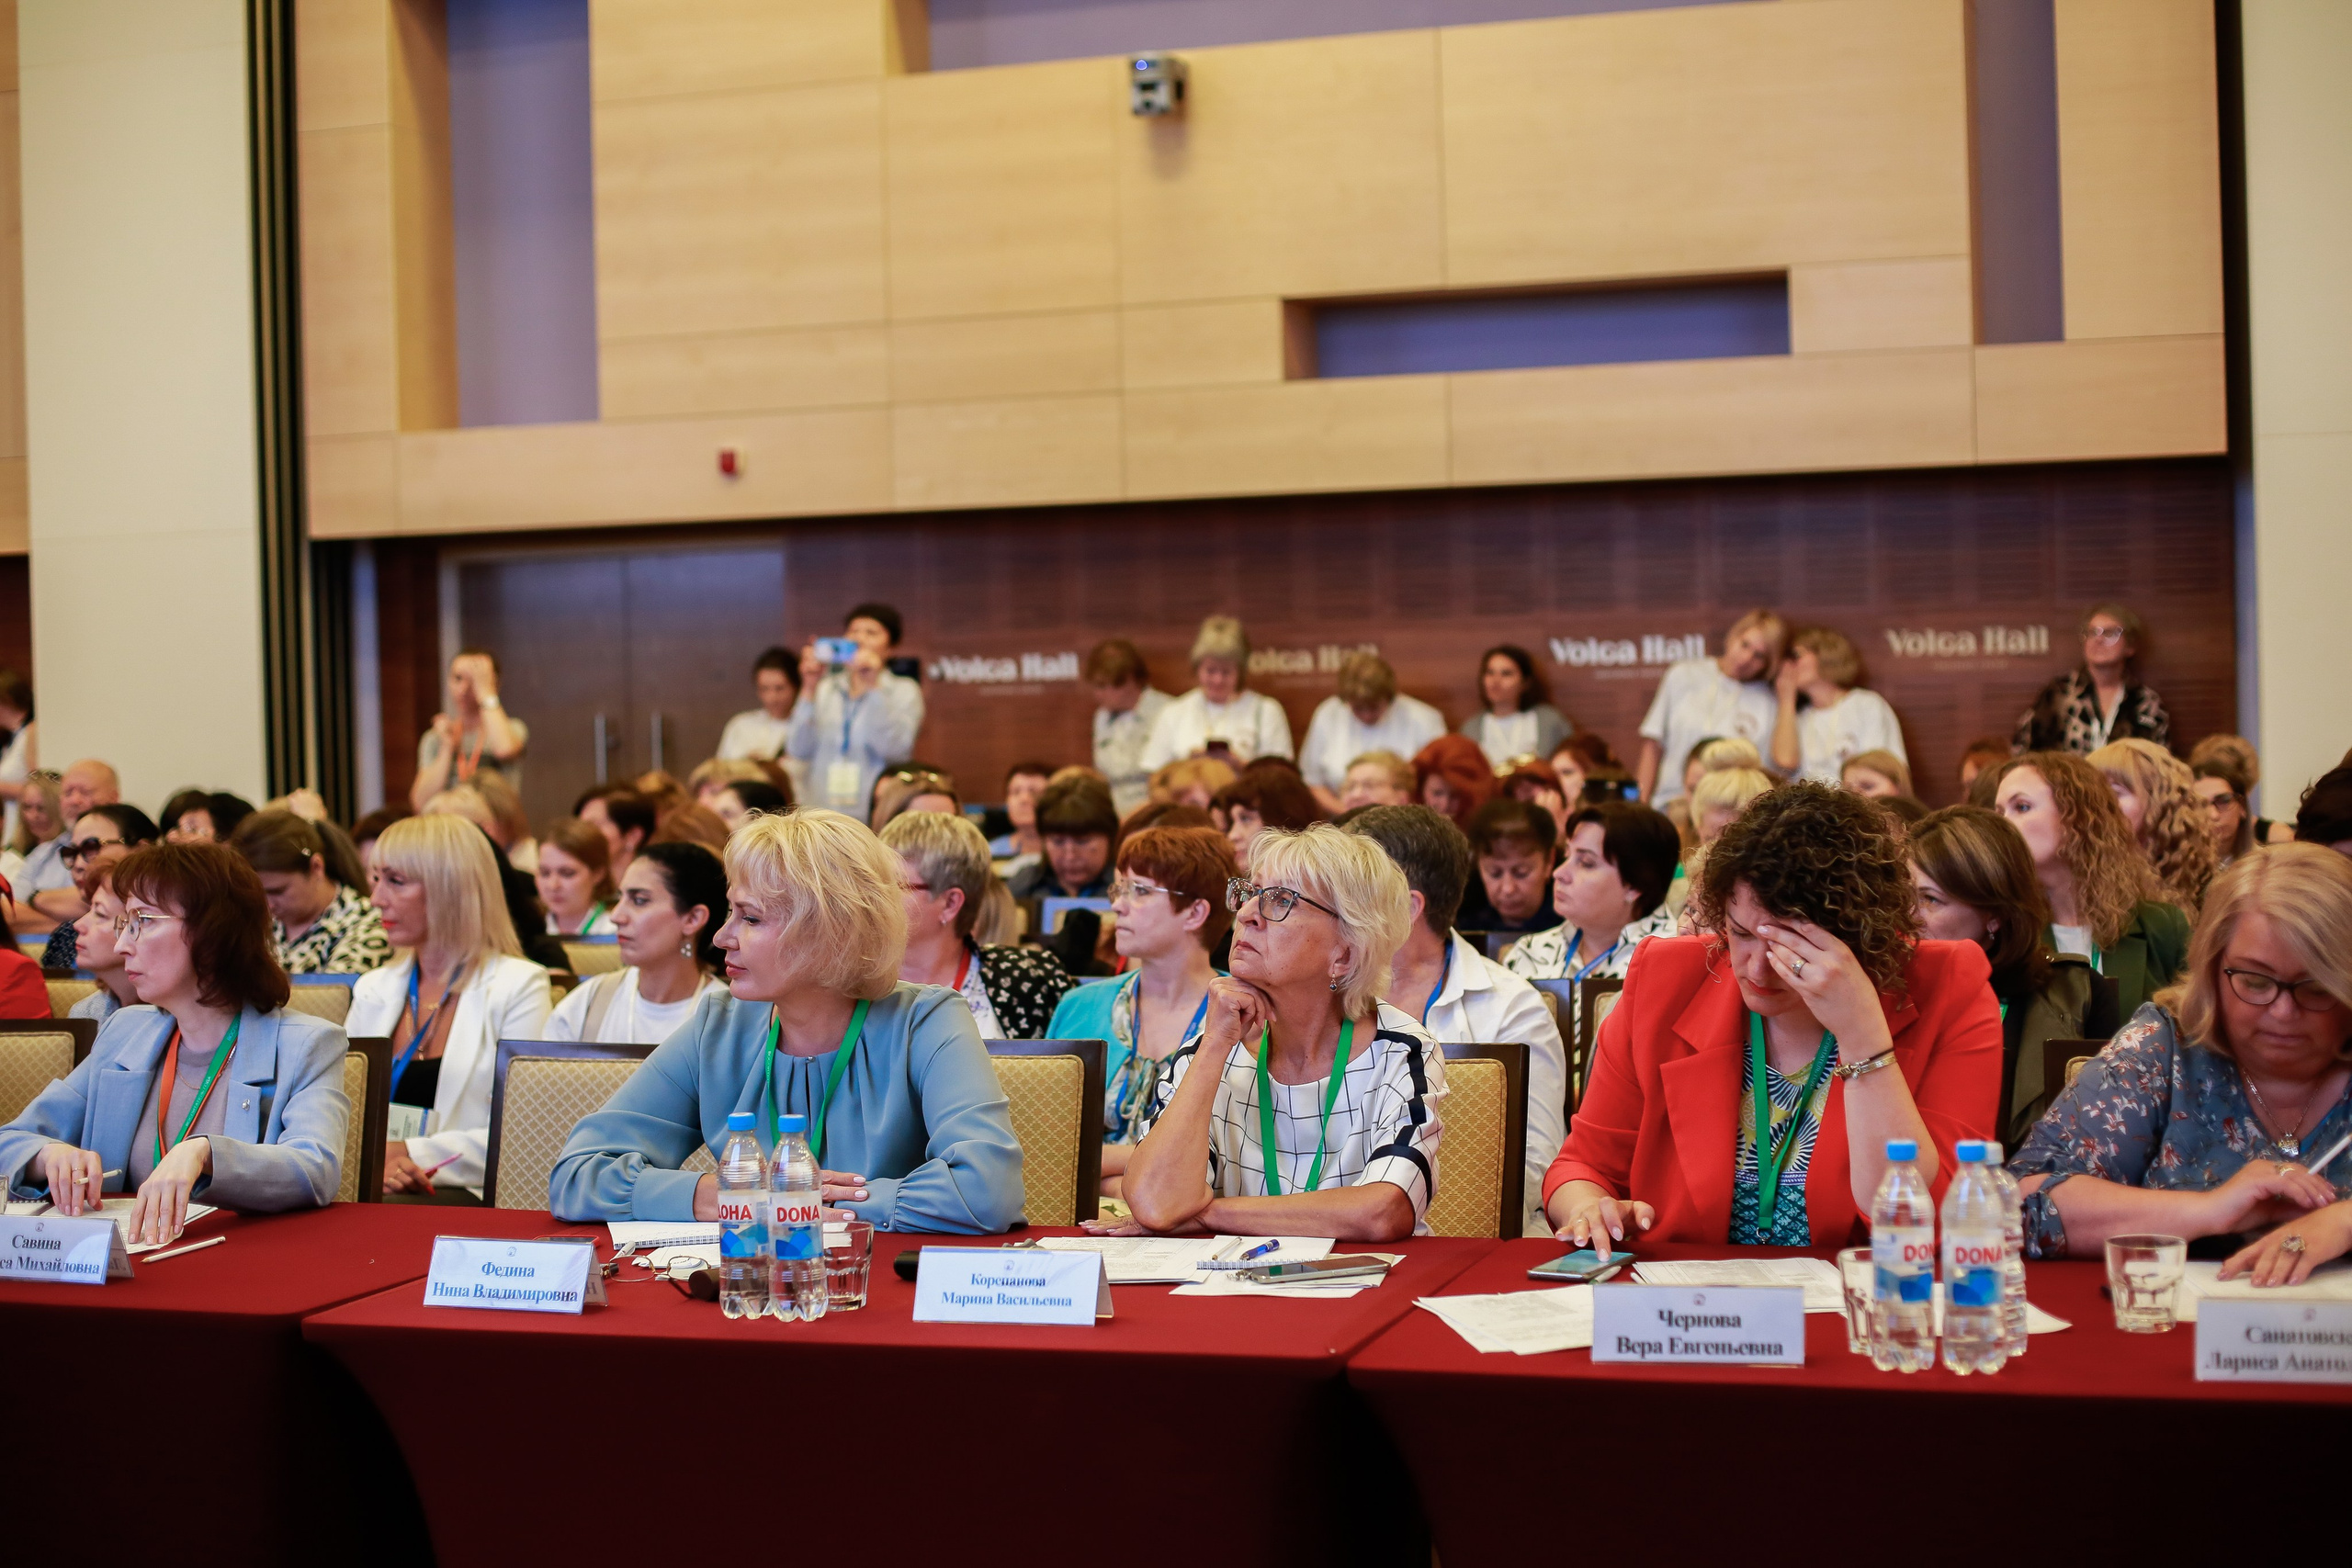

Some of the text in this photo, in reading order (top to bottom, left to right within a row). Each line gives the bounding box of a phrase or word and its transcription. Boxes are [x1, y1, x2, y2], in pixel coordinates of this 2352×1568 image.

[1641, 634, 1706, 665] Hall
[1982, 625, 2049, 656] Hall
[1020, 652, 1080, 681] Hall
[1815, 1032, 1833, 1074] ОСПИТАТЕЛЬ
[776, 1205, 820, 1223] DONA
[12, 1234, 61, 1250] Савина
[17, 1256, 99, 1274] Михайловна
[481, 1261, 535, 1278] Федина
[971, 1273, 1046, 1289] Корепанова
[432, 1281, 469, 1298] Нина
[473, 1283, 578, 1304] Владимировна
[942, 1292, 1072, 1307] Марина Васильевна
[1657, 1309, 1742, 1332] Чернова
[1616, 1337, 1783, 1359] Вера Евгеньевна
[2205, 1350, 2279, 1374] Лариса
